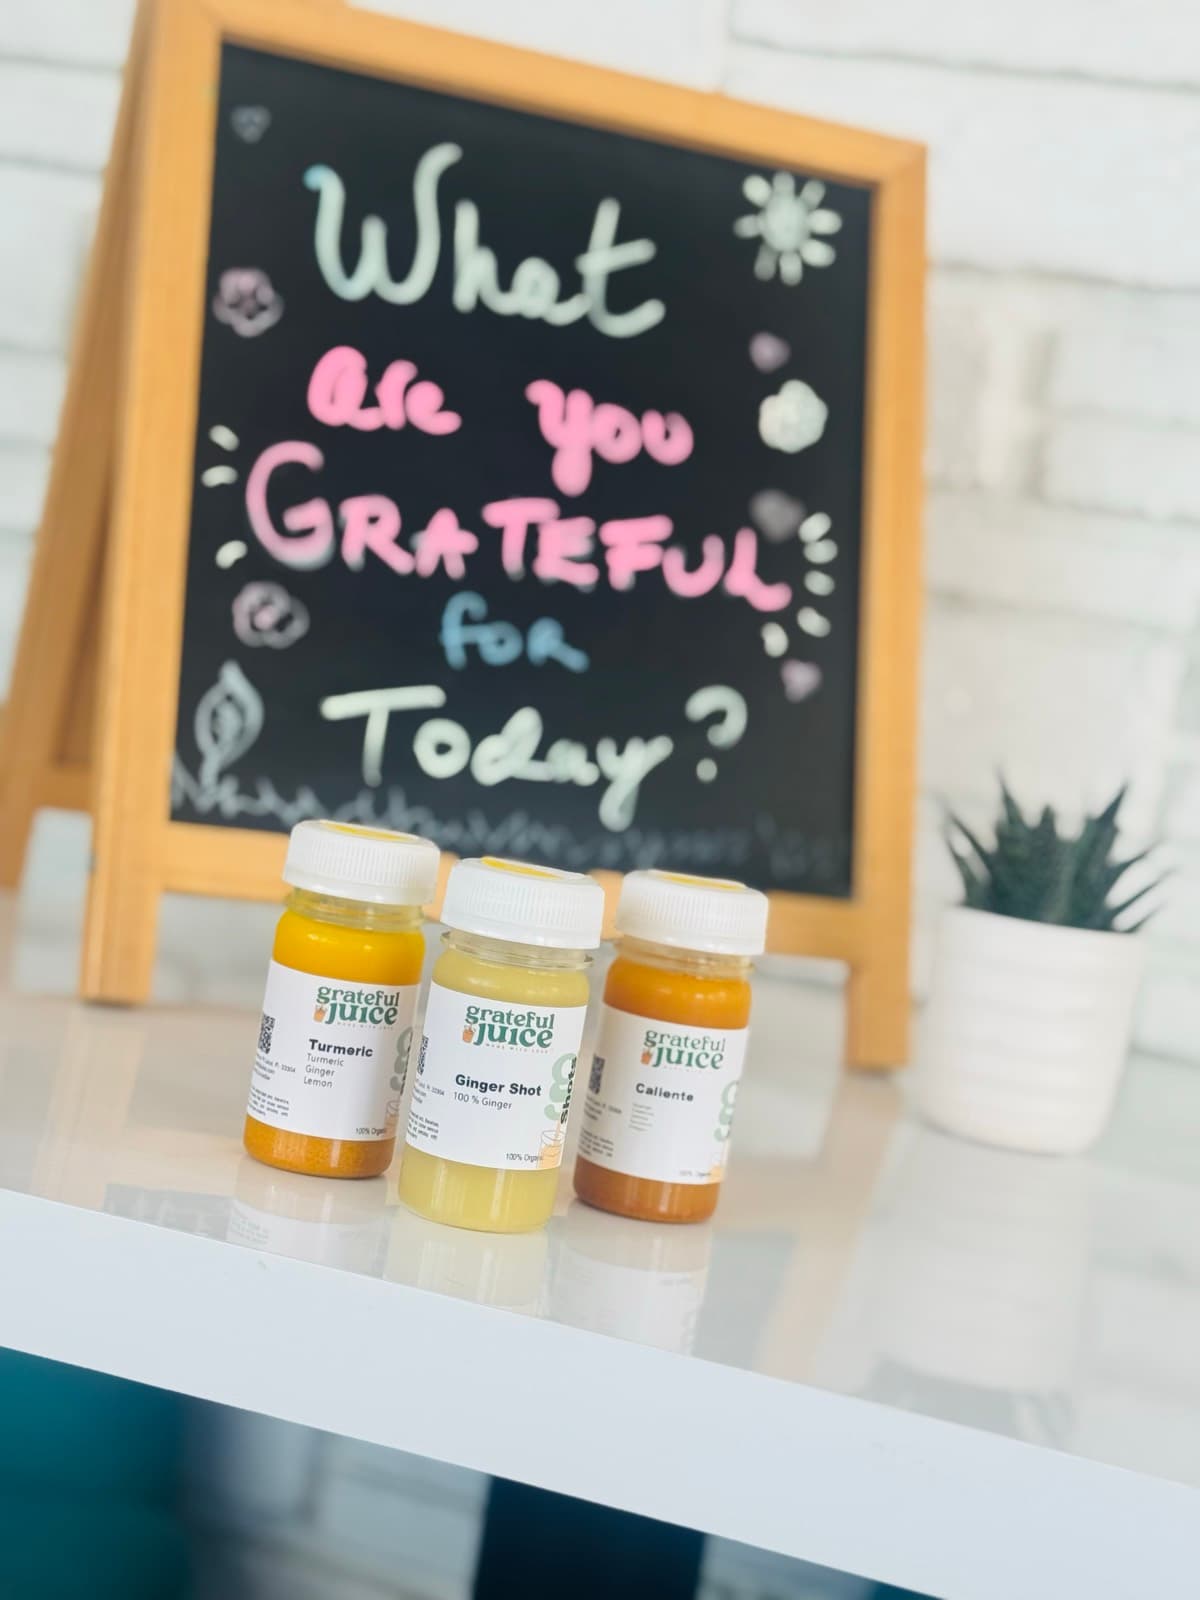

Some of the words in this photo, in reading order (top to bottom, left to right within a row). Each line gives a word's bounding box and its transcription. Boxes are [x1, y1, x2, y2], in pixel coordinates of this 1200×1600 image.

[304, 142, 665, 338] What
[525, 379, 694, 497] you
[246, 441, 792, 612] GRATEFUL
[316, 986, 400, 1007] grateful
[465, 1005, 555, 1029] grateful
[309, 1038, 374, 1057] Turmeric
[643, 1030, 726, 1052] grateful
[307, 1053, 345, 1067] Turmeric
[303, 1075, 333, 1088] Lemon
[305, 1064, 335, 1078] Ginger
[455, 1074, 505, 1094] Ginger
[508, 1083, 542, 1097] Shot
[635, 1082, 694, 1102] Caliente
[454, 1091, 470, 1103] 100
[471, 1095, 480, 1105] %
[481, 1097, 512, 1110] Ginger
